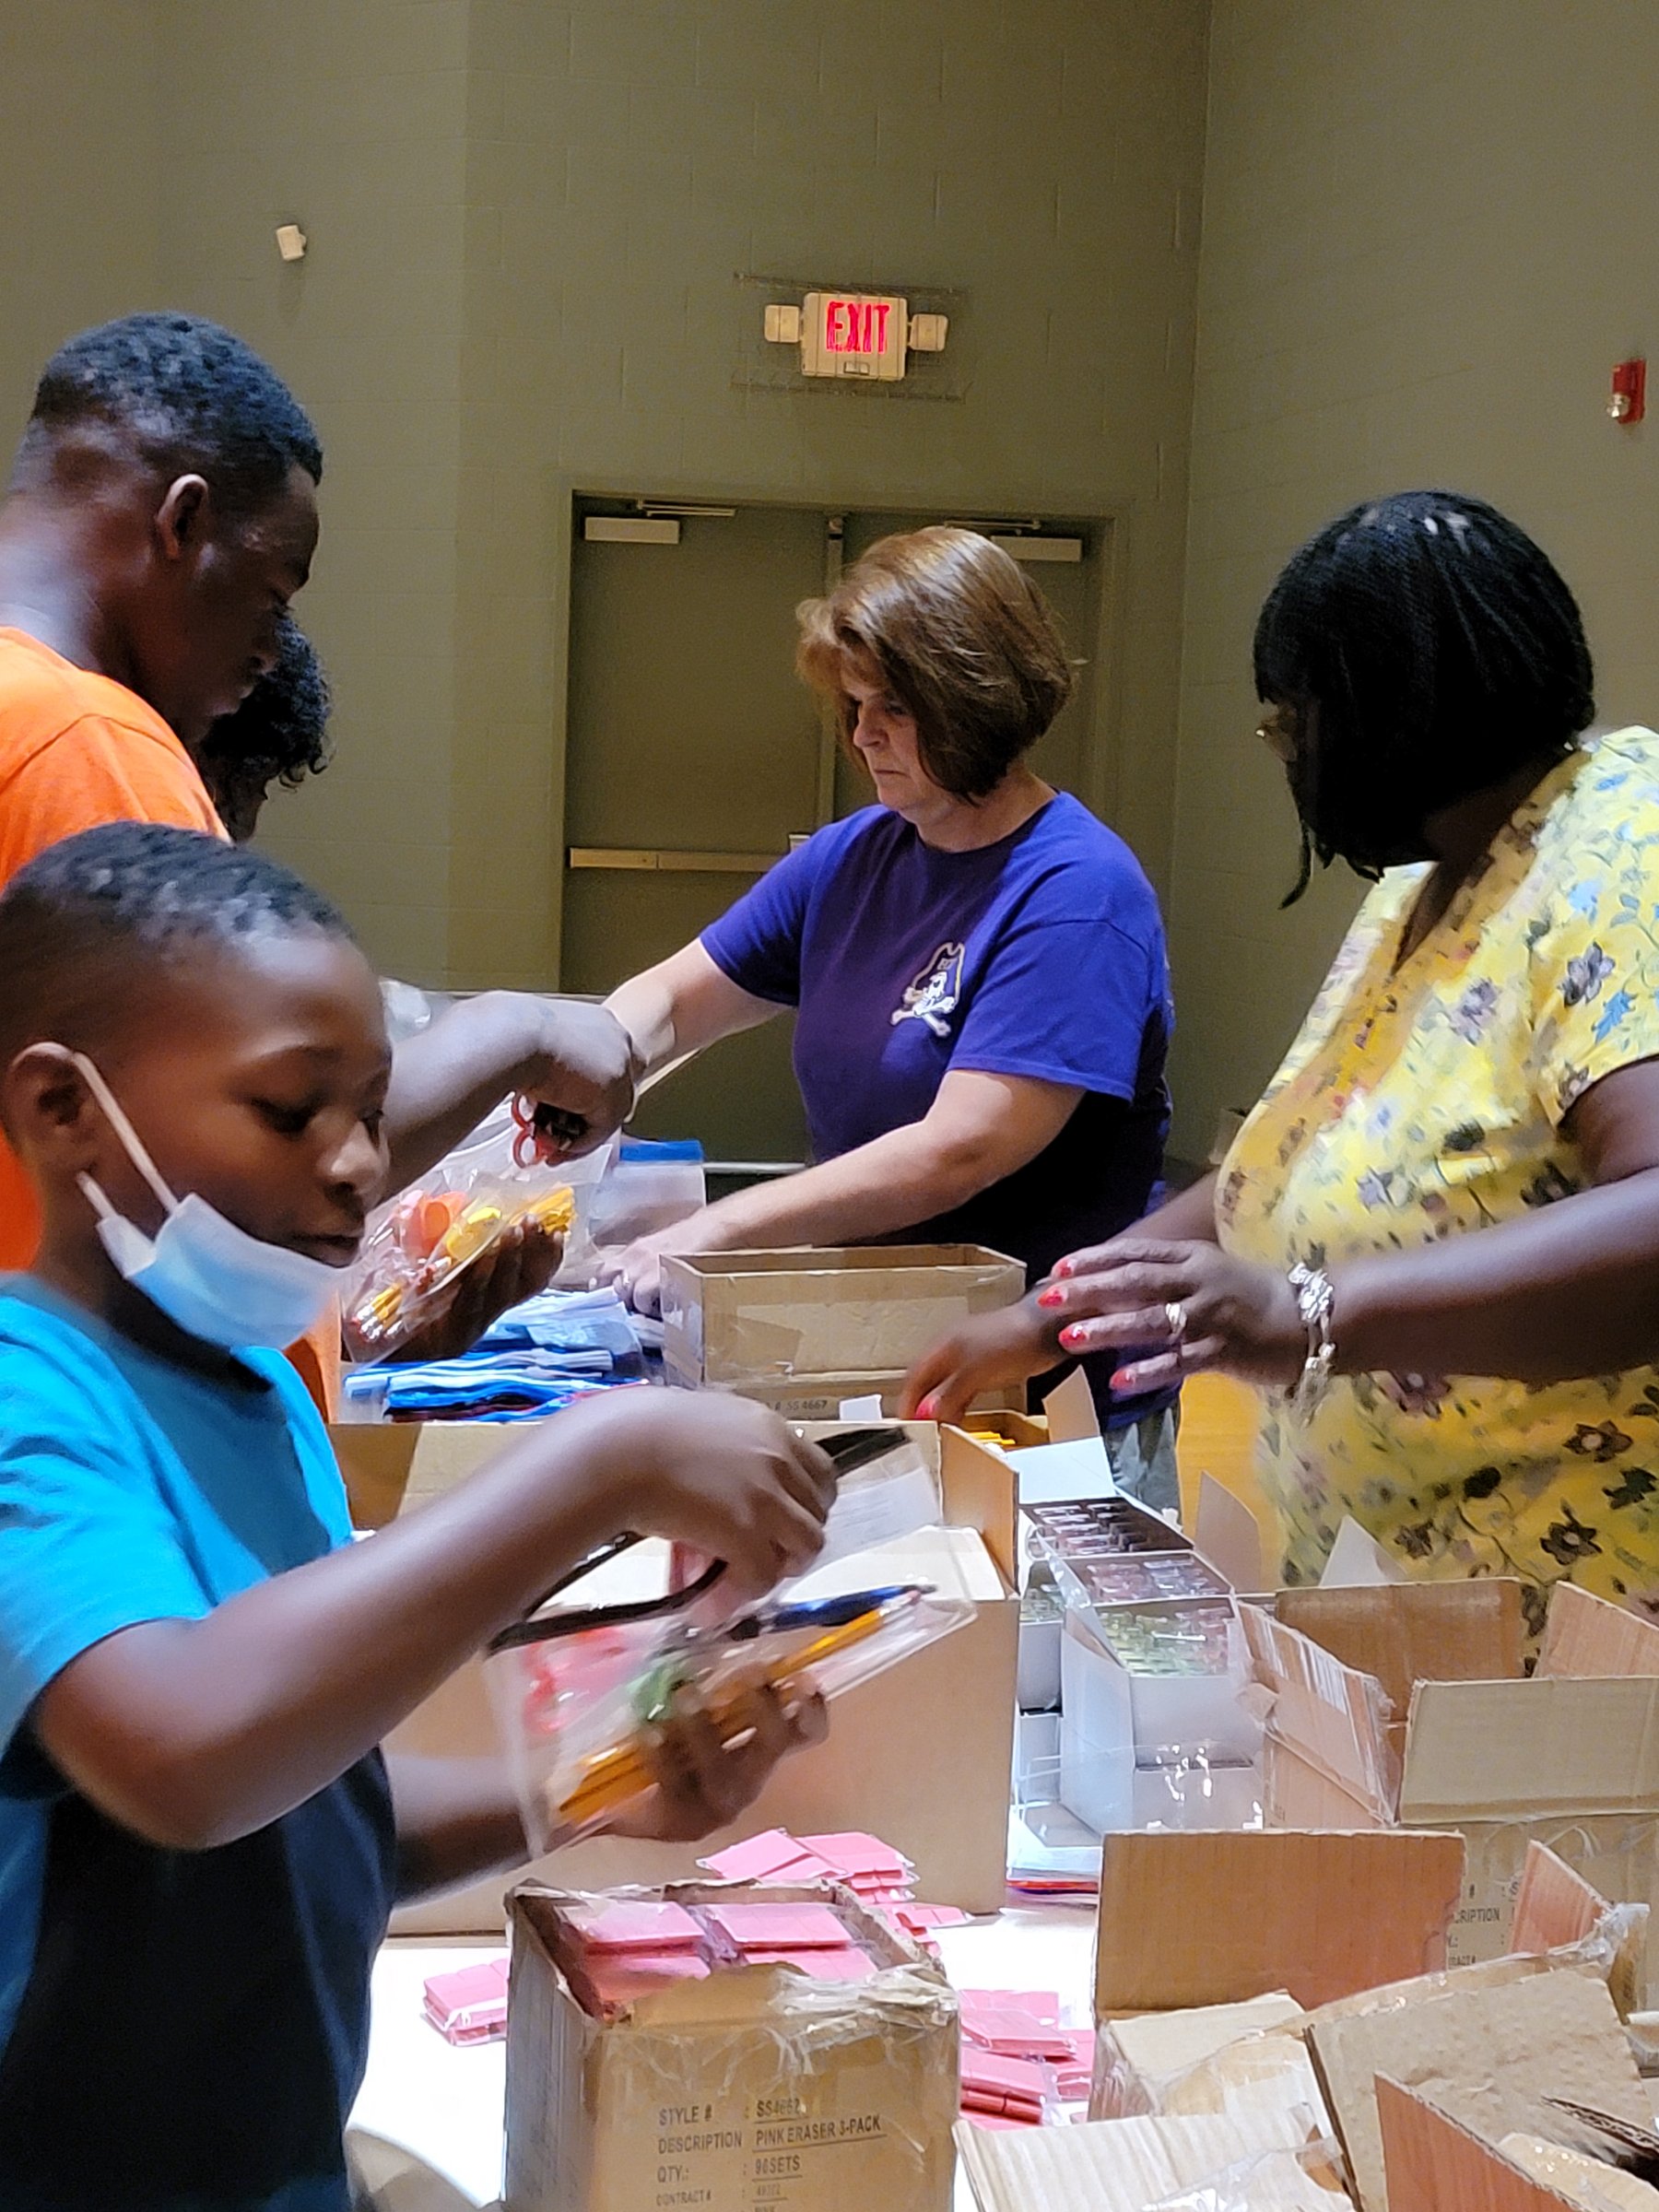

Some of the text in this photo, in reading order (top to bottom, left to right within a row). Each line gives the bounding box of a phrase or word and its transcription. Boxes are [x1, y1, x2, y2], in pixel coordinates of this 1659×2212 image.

[827, 300, 890, 354] EXIT
[659, 2105, 700, 2126] STYLE
[658, 2131, 742, 2155] DESCRIPTION
[756, 2127, 784, 2147] PINK
[787, 2122, 836, 2144] ERASER
[656, 2190, 704, 2206] CONTRACT
